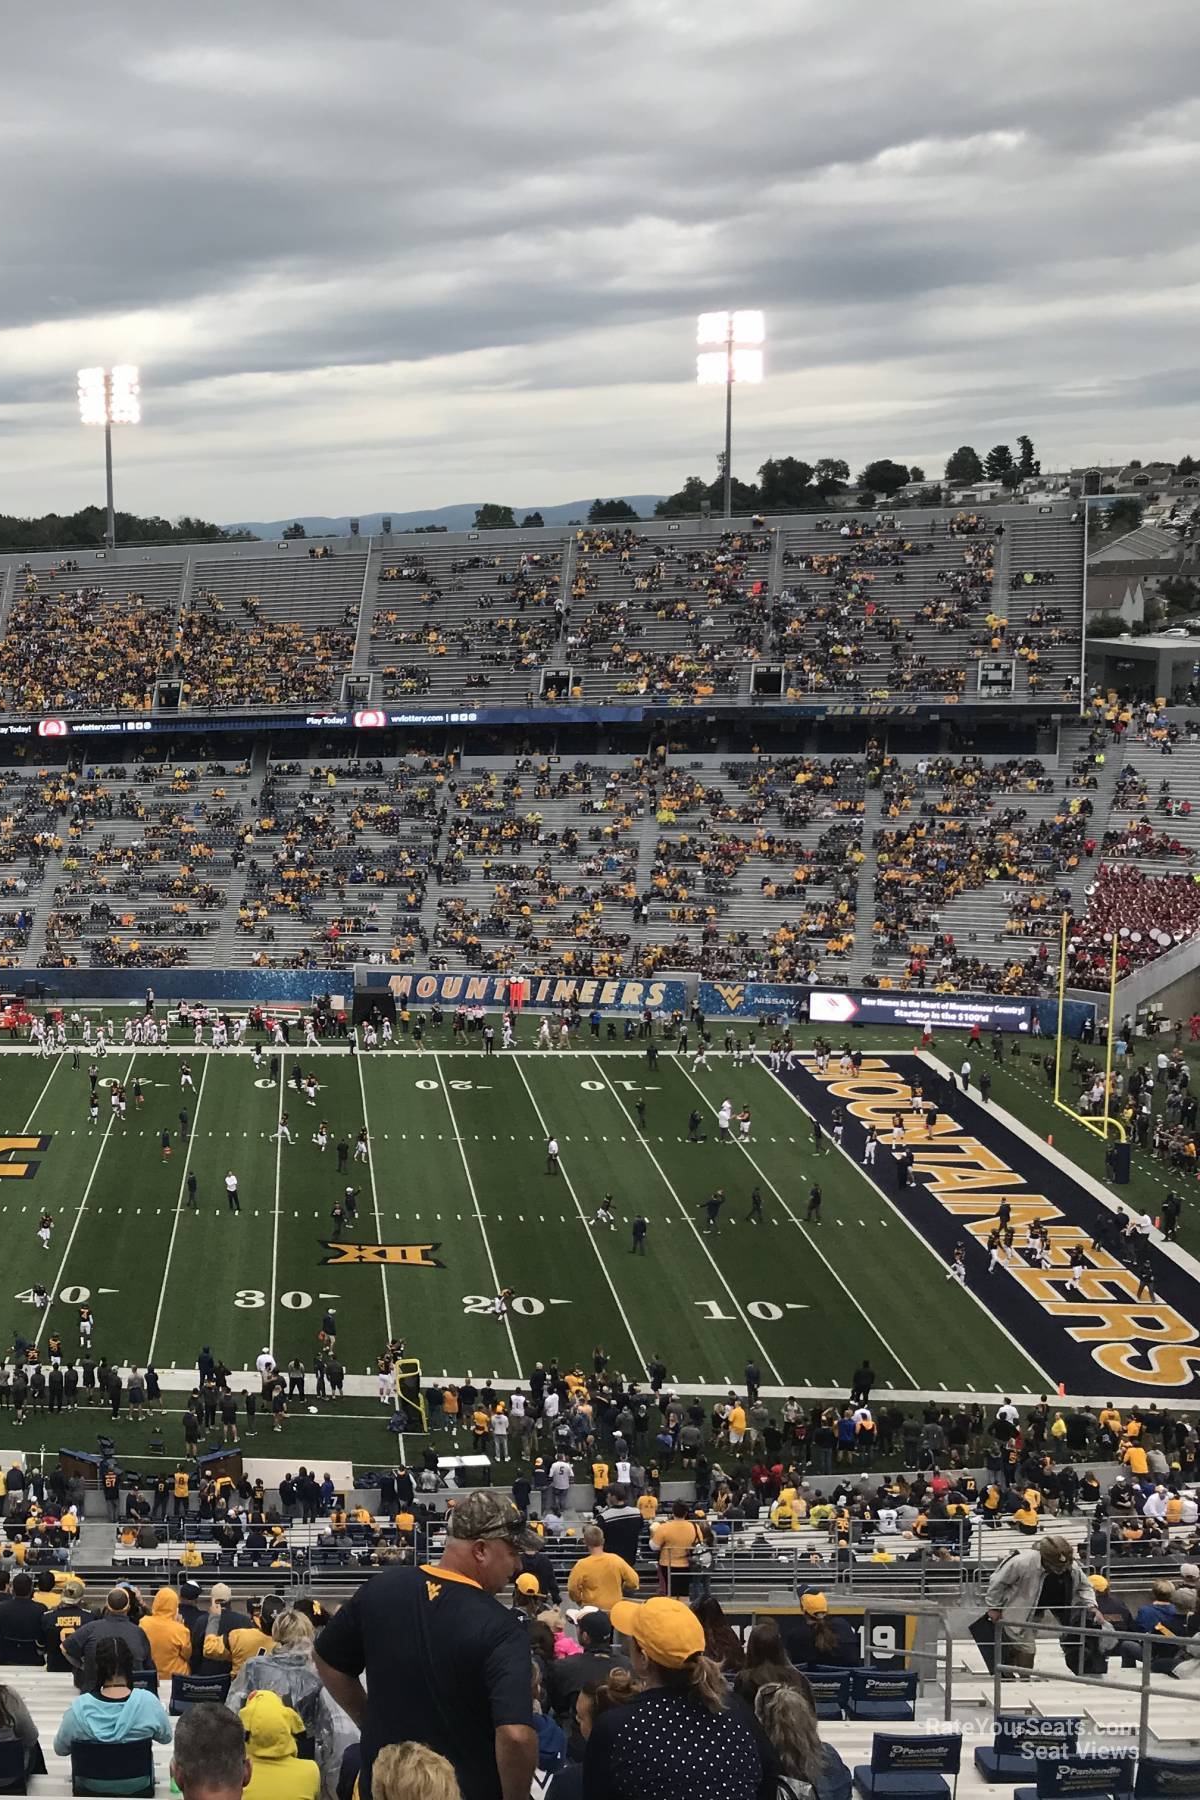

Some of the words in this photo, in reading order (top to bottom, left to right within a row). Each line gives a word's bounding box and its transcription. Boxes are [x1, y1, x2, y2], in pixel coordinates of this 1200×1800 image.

[825, 705, 855, 715] SAM
[860, 705, 895, 715] HUFF
[899, 705, 917, 715] 75
[306, 717, 322, 726] Play
[323, 716, 346, 725] Today!
[390, 714, 443, 723] wvlottery.com
[9, 725, 31, 734] Today!
[72, 723, 121, 731] wvlottery.com
[754, 997, 795, 1006] NISSAN
[862, 998, 876, 1006] New
[877, 999, 899, 1007] Homes
[909, 1000, 920, 1008] the
[921, 1001, 940, 1009] Heart
[941, 1002, 949, 1010] of
[950, 1003, 993, 1012] Mountaineer
[994, 1006, 1025, 1015] Country!
[894, 1009, 930, 1019] Starting
[941, 1012, 957, 1020] the
[415, 1079, 472, 1090] 20
[580, 1080, 637, 1091] 10
[796, 1058, 1200, 1388] MOUNTAINEERS
[14, 1286, 91, 1304] 40
[234, 1290, 313, 1310] 30
[462, 1295, 545, 1316] 20
[694, 1300, 784, 1321] 10
[967, 1481, 975, 1490] 12
[56, 1616, 83, 1627] JOSEPH
[851, 1625, 896, 1660] 19
[1070, 1766, 1122, 1777] Panhandle
